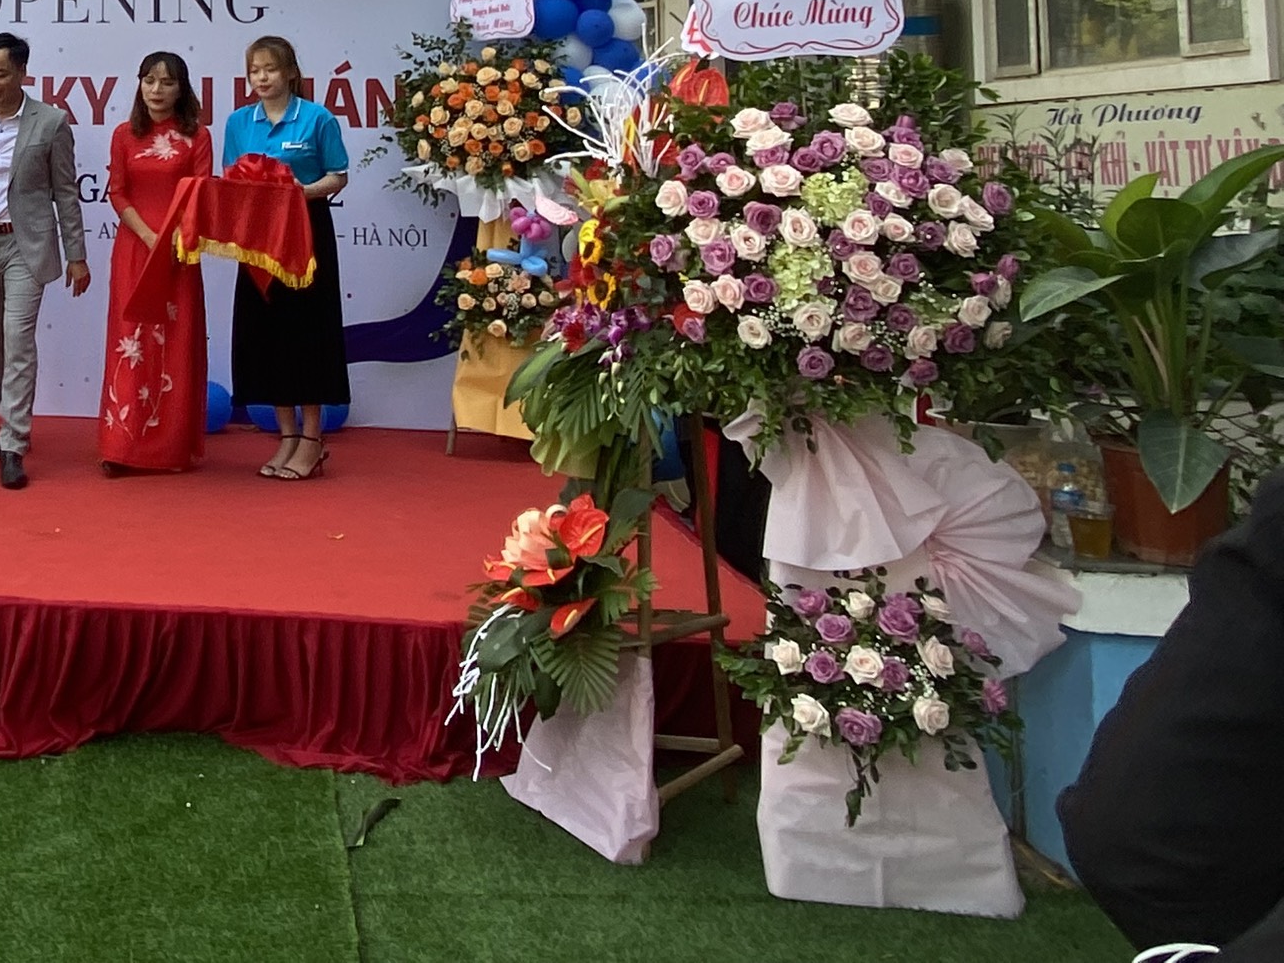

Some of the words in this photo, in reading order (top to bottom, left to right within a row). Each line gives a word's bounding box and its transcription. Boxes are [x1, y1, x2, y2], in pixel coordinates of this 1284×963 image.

[734, 1, 795, 29] Chúc
[1046, 107, 1083, 126] Hà
[1092, 102, 1203, 128] Phương
[1184, 134, 1213, 183] TƯ
[352, 223, 382, 246] HÀ
[388, 223, 428, 251] NỘI
